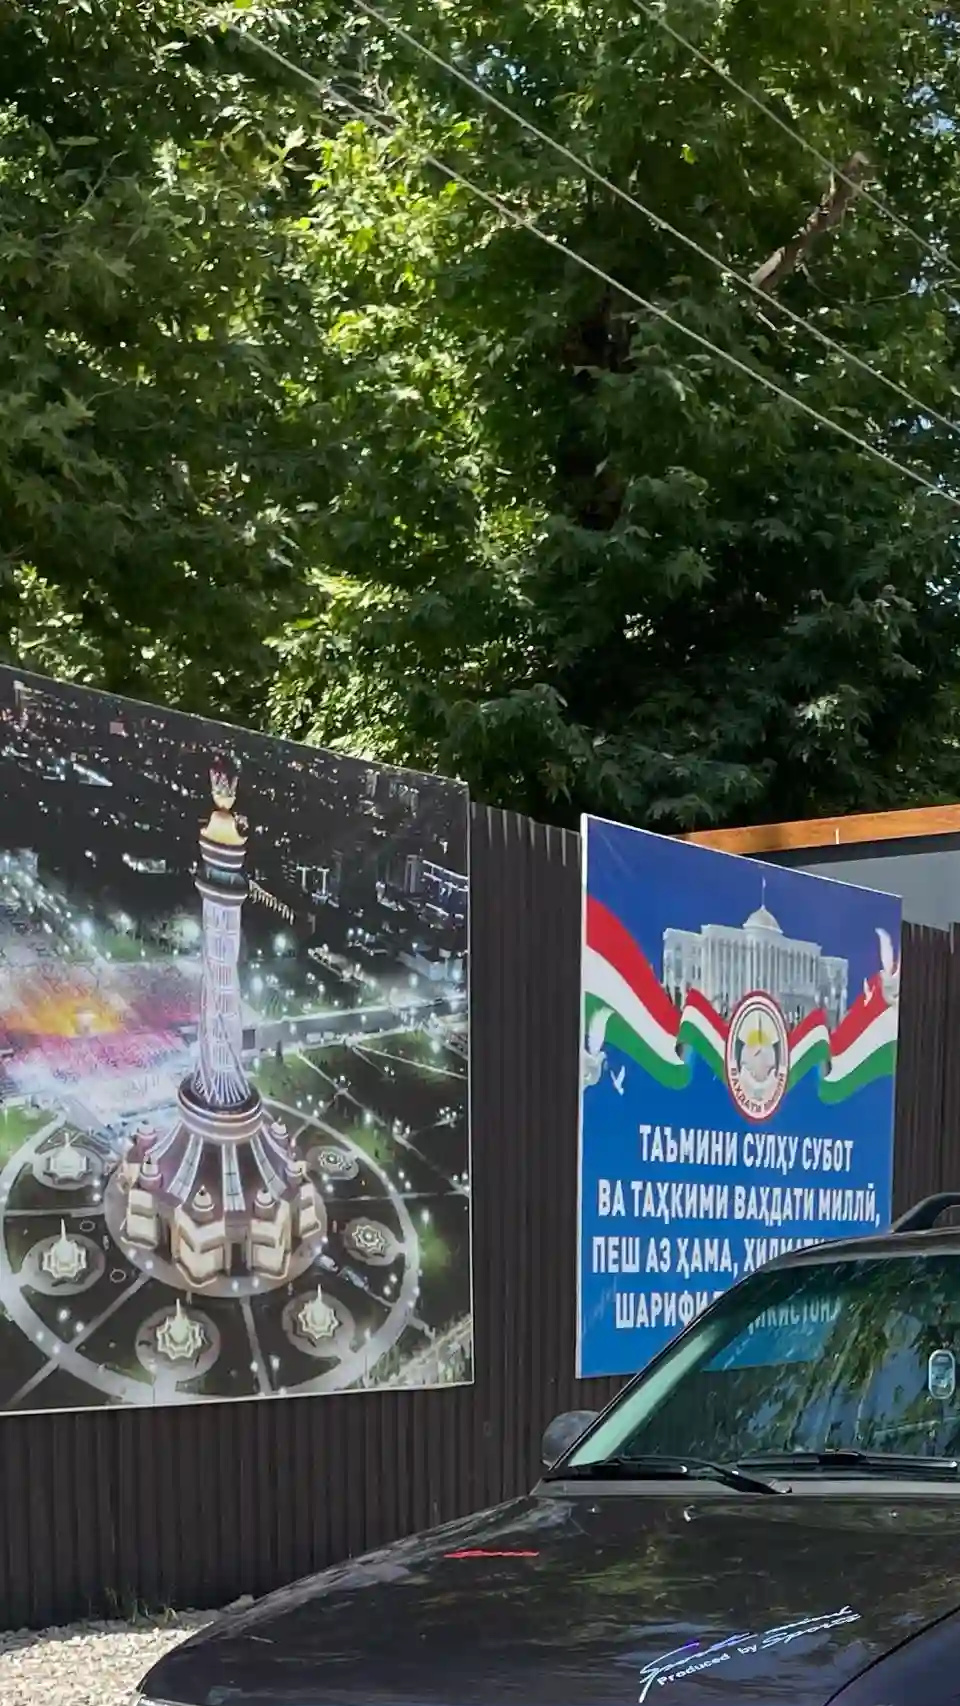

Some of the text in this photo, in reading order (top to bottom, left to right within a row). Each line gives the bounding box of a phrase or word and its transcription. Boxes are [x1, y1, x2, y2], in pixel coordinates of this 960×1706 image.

[639, 1124, 854, 1175] ТАЪМИНИ СУЛҲУ СУБОТ
[598, 1178, 881, 1227] ВА ТАҲКИМИ ВАҲДАТИ МИЛЛӢ,
[592, 1236, 640, 1274] ПЕШ
[646, 1237, 672, 1273] АЗ
[675, 1237, 739, 1279] ҲАМА,
[657, 1652, 731, 1687] Produced
[737, 1643, 759, 1656] by
